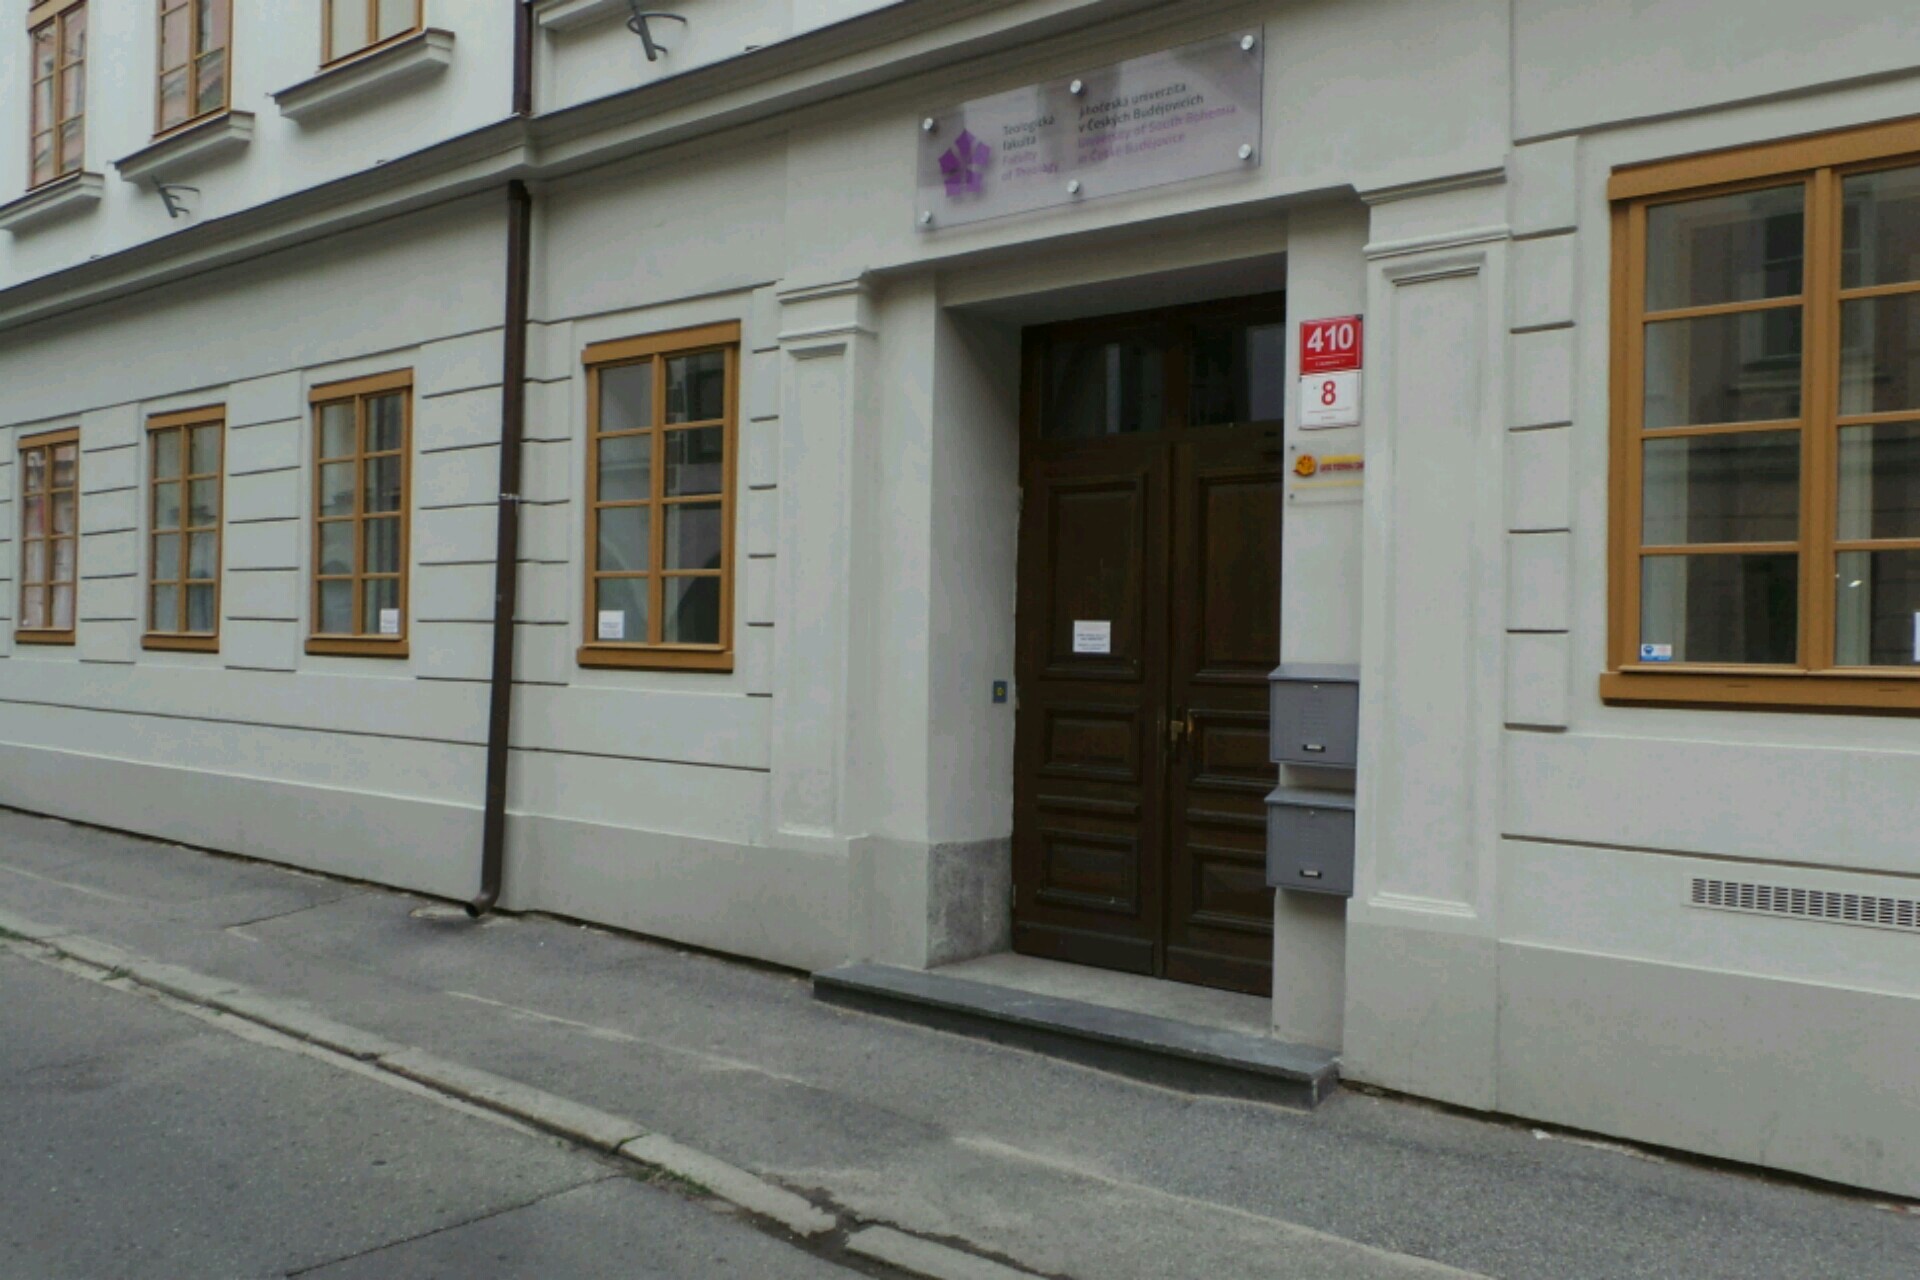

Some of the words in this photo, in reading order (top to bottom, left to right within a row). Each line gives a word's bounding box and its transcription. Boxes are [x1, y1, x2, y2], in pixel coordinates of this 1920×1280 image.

[1131, 82, 1186, 104] univerzita
[1306, 323, 1355, 352] 410
[1321, 380, 1336, 406] 8
